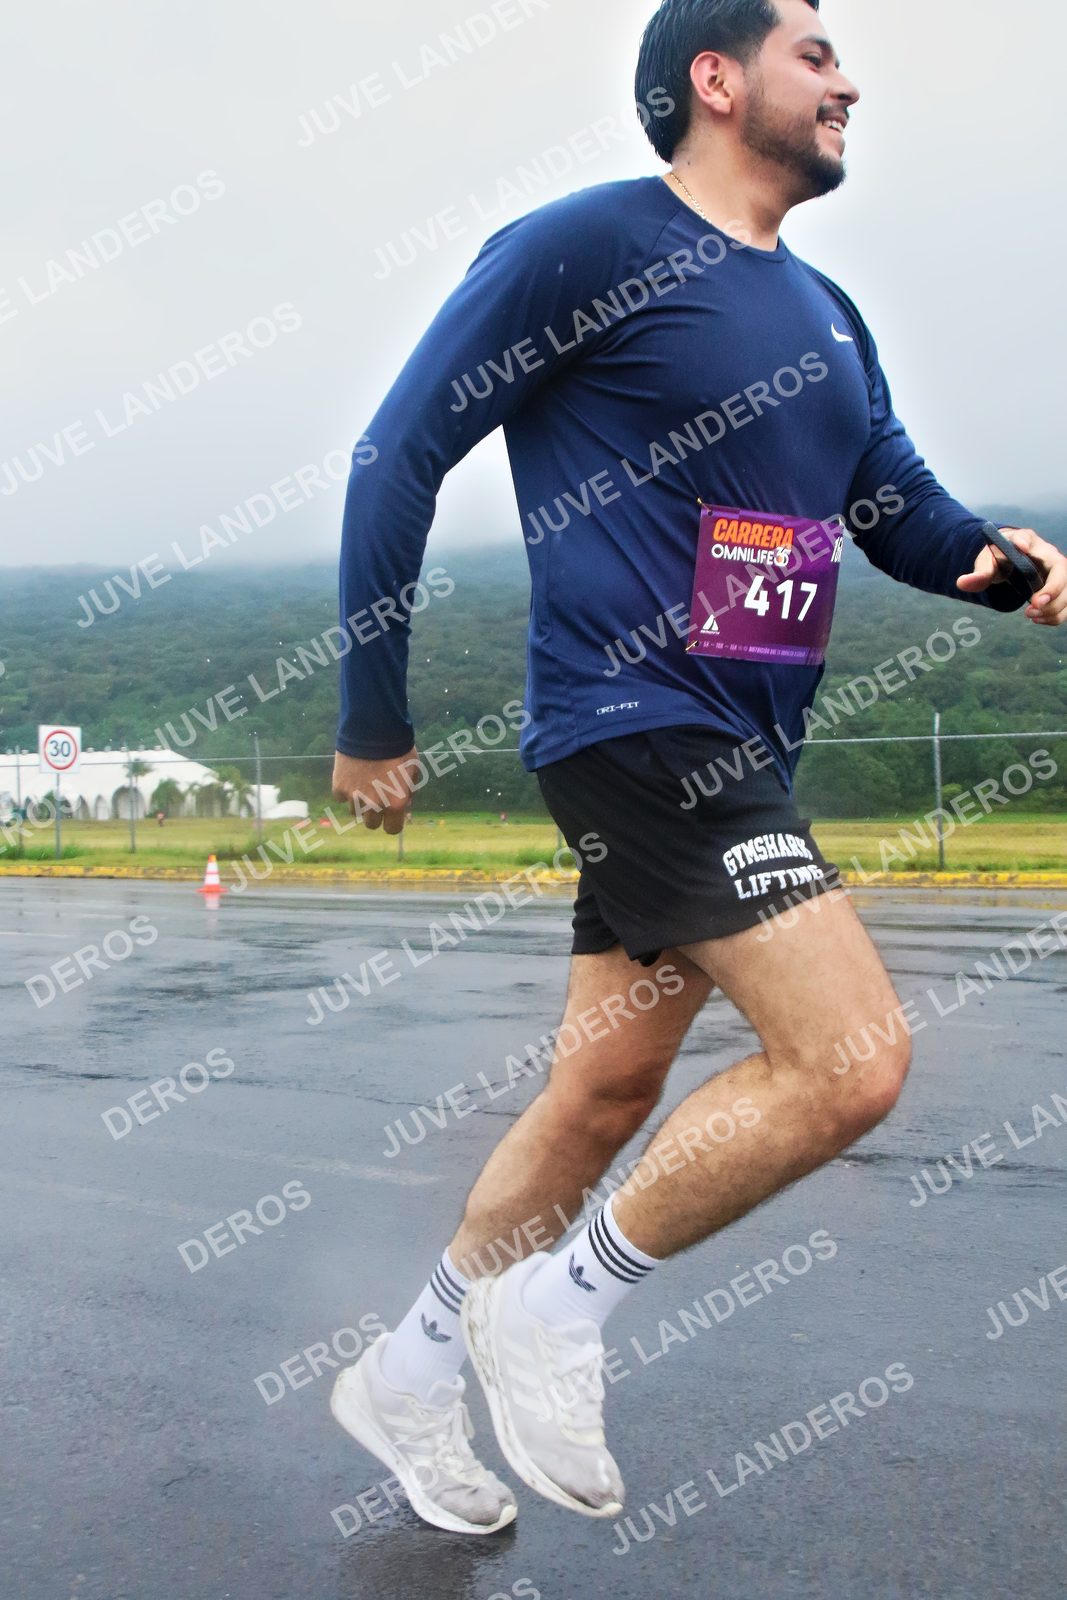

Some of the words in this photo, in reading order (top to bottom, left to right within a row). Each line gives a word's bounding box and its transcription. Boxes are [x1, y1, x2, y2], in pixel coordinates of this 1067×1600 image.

[713, 518, 794, 550] CARRERA
[711, 543, 775, 566] OMNILIFE
[744, 575, 817, 622] 417
[596, 701, 640, 716] DRI-FIT
[49, 740, 71, 757] 30
[722, 832, 814, 877] GYMSHARK
[734, 864, 824, 900] LIFTING
